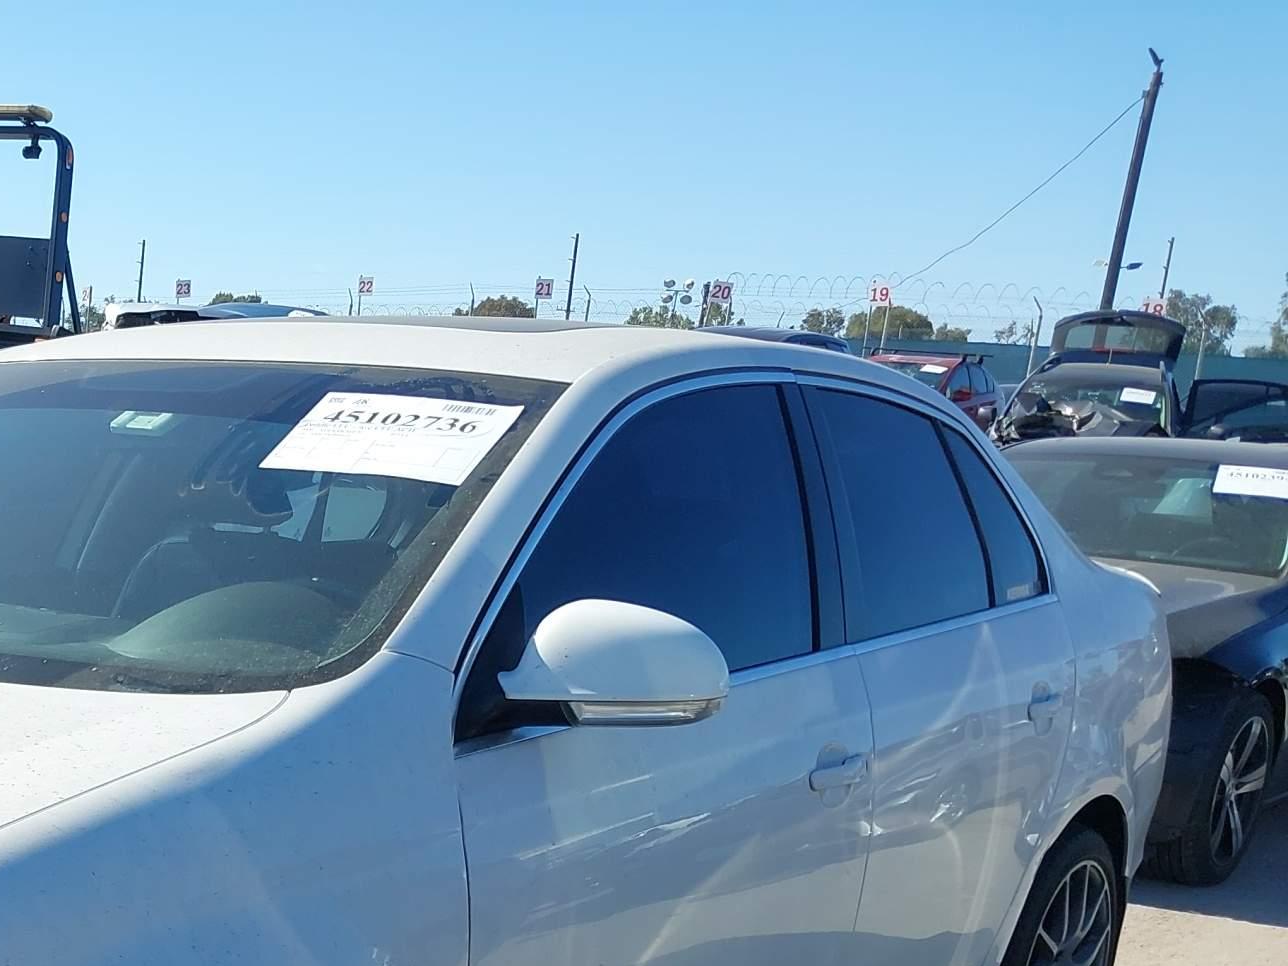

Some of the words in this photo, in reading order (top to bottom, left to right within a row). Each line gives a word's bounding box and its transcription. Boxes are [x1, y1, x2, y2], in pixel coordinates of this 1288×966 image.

[177, 283, 191, 295] 23
[359, 280, 373, 293] 22
[536, 282, 552, 296] 21
[712, 284, 731, 300] 20
[870, 287, 889, 302] 19
[1143, 302, 1164, 318] 18
[323, 408, 485, 435] 45102736
